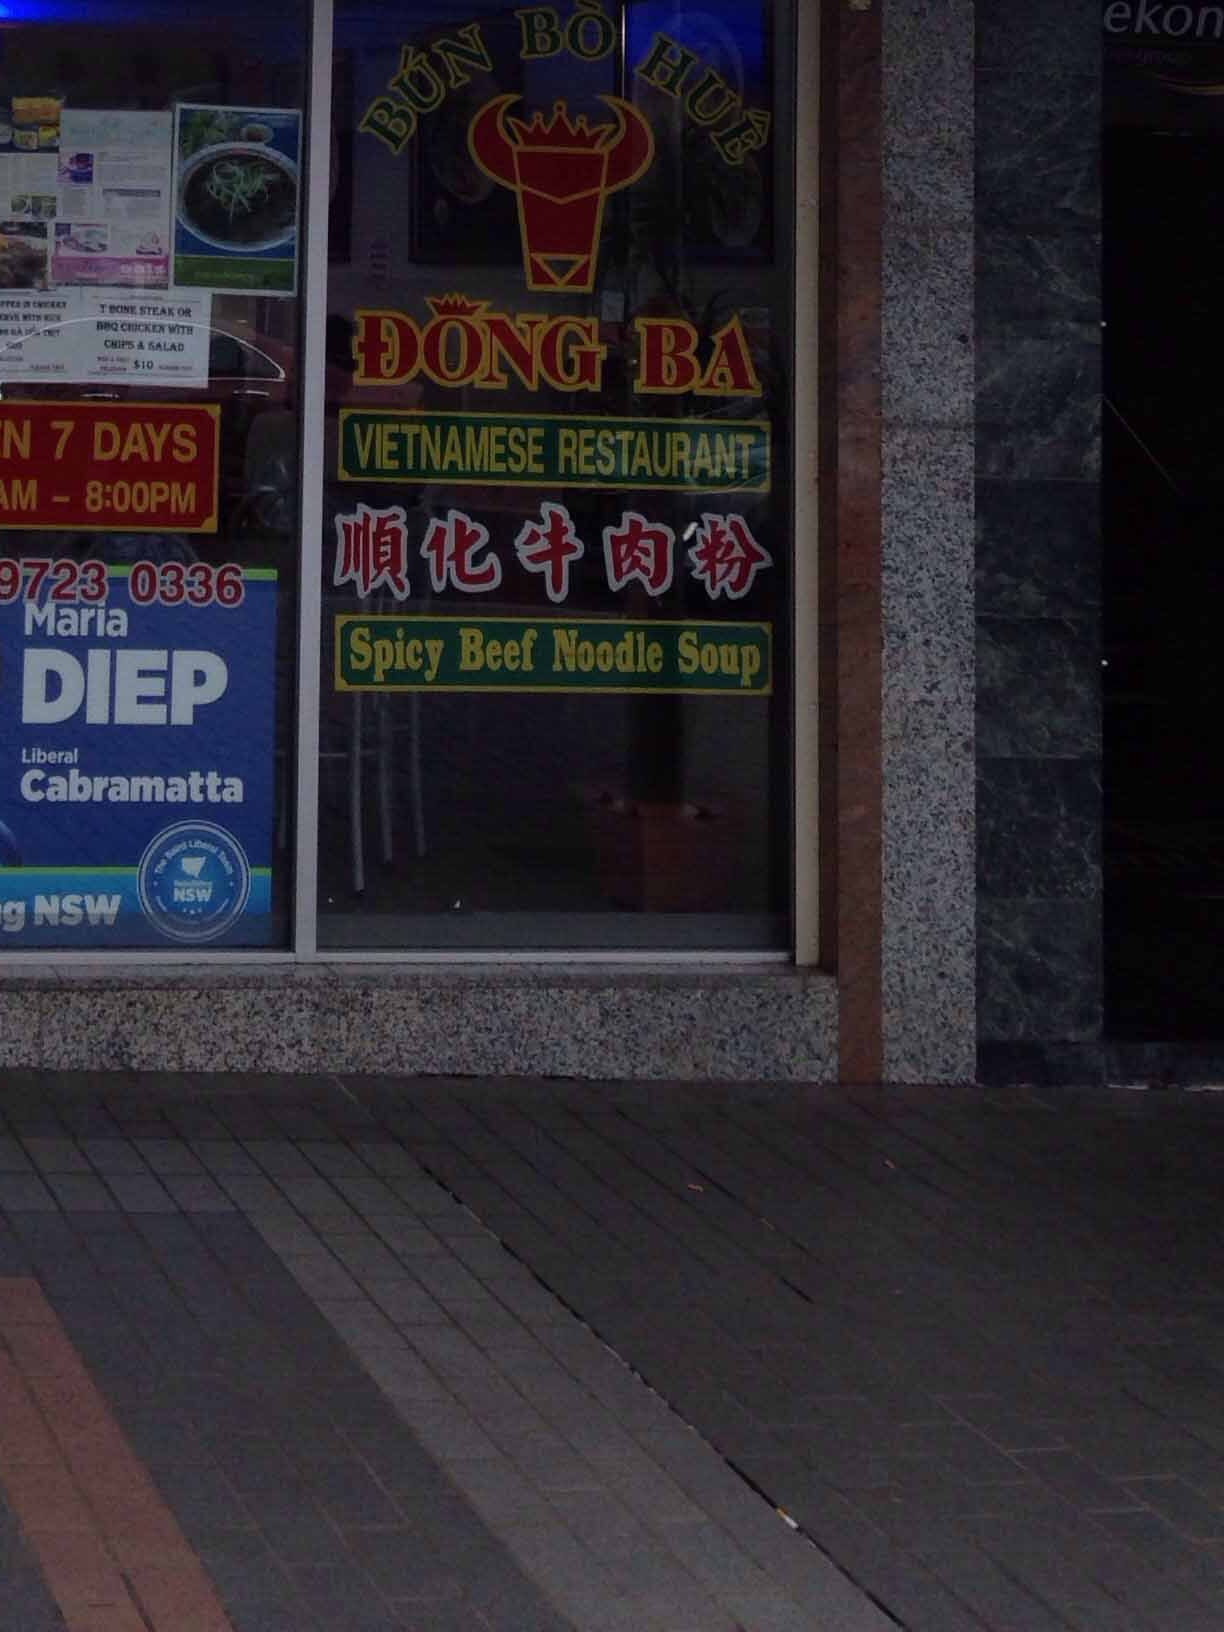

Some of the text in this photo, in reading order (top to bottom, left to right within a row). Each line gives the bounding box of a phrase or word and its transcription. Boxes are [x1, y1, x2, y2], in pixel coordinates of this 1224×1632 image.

[361, 23, 493, 155] BÚN
[635, 313, 763, 397] BA
[50, 421, 75, 460] 7
[93, 423, 198, 463] DAYS
[354, 423, 757, 480] VIETNAMESE RESTAURANT
[85, 480, 197, 514] 8:00PM
[335, 501, 773, 604] 順化牛肉粉
[129, 563, 245, 606] 0336
[23, 602, 129, 638] Maria
[350, 626, 762, 686] Spicy Beef Noodle Soup
[21, 648, 229, 726] DIEP
[21, 747, 78, 765] Liberal
[20, 769, 244, 804] Cabramatta
[34, 894, 122, 926] NSW
